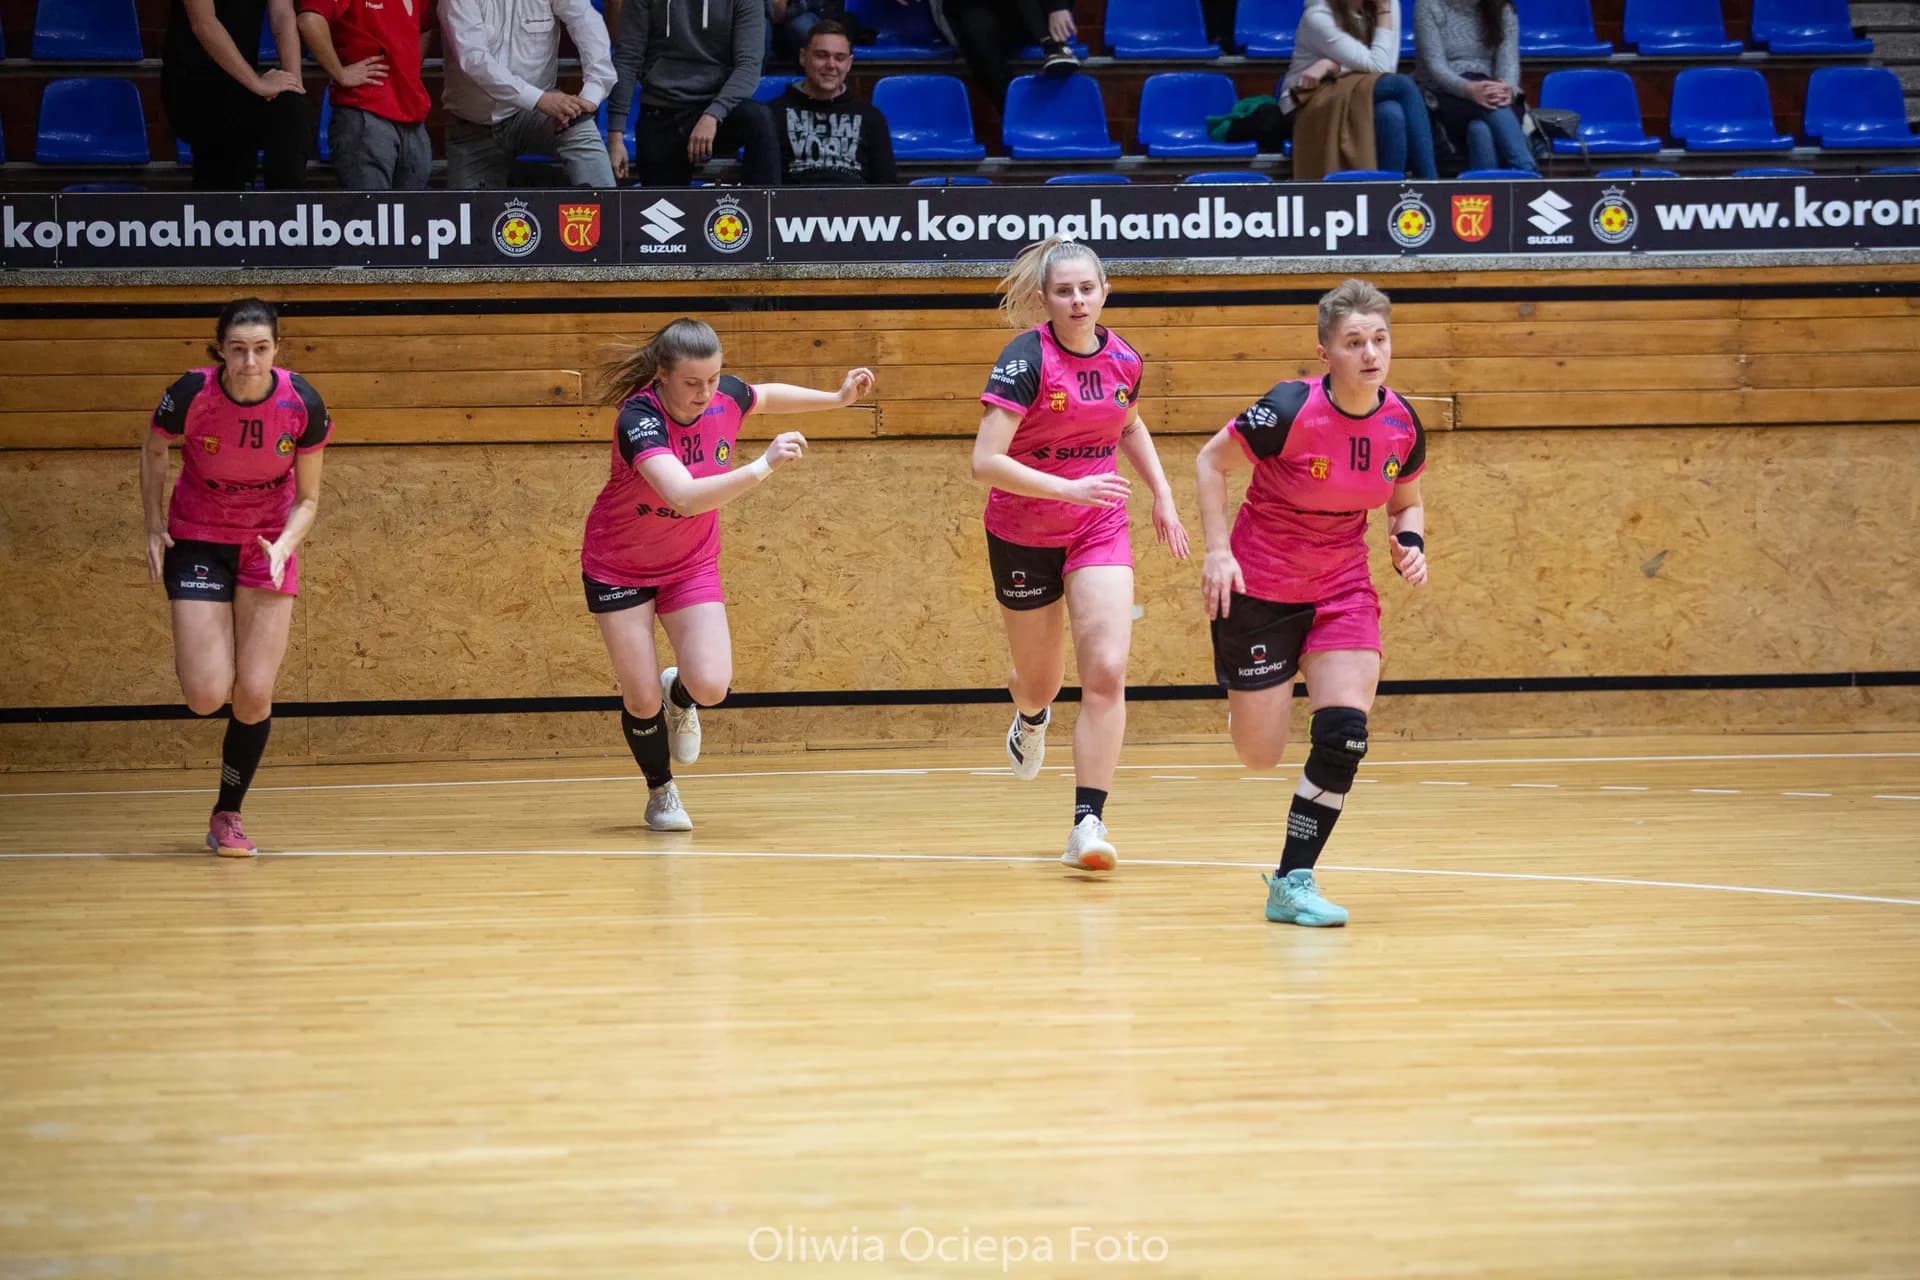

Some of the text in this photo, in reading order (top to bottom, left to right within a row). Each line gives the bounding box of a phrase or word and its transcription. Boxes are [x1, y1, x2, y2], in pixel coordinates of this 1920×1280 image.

[786, 108, 862, 139] NEW
[788, 131, 862, 171] YORK
[775, 195, 1369, 250] www.koronahandball.pl
[1655, 186, 1920, 229] www.koron
[3, 203, 471, 259] koronahandball.pl
[564, 224, 592, 246] CK
[1456, 214, 1485, 237] CK
[1527, 235, 1574, 245] SUZUKI
[640, 244, 687, 253] SUZUKI
[1077, 370, 1104, 400] 20
[238, 419, 264, 449] 79
[680, 433, 704, 466] 32
[1055, 446, 1116, 460] SUZUK
[1349, 436, 1371, 471] 19
